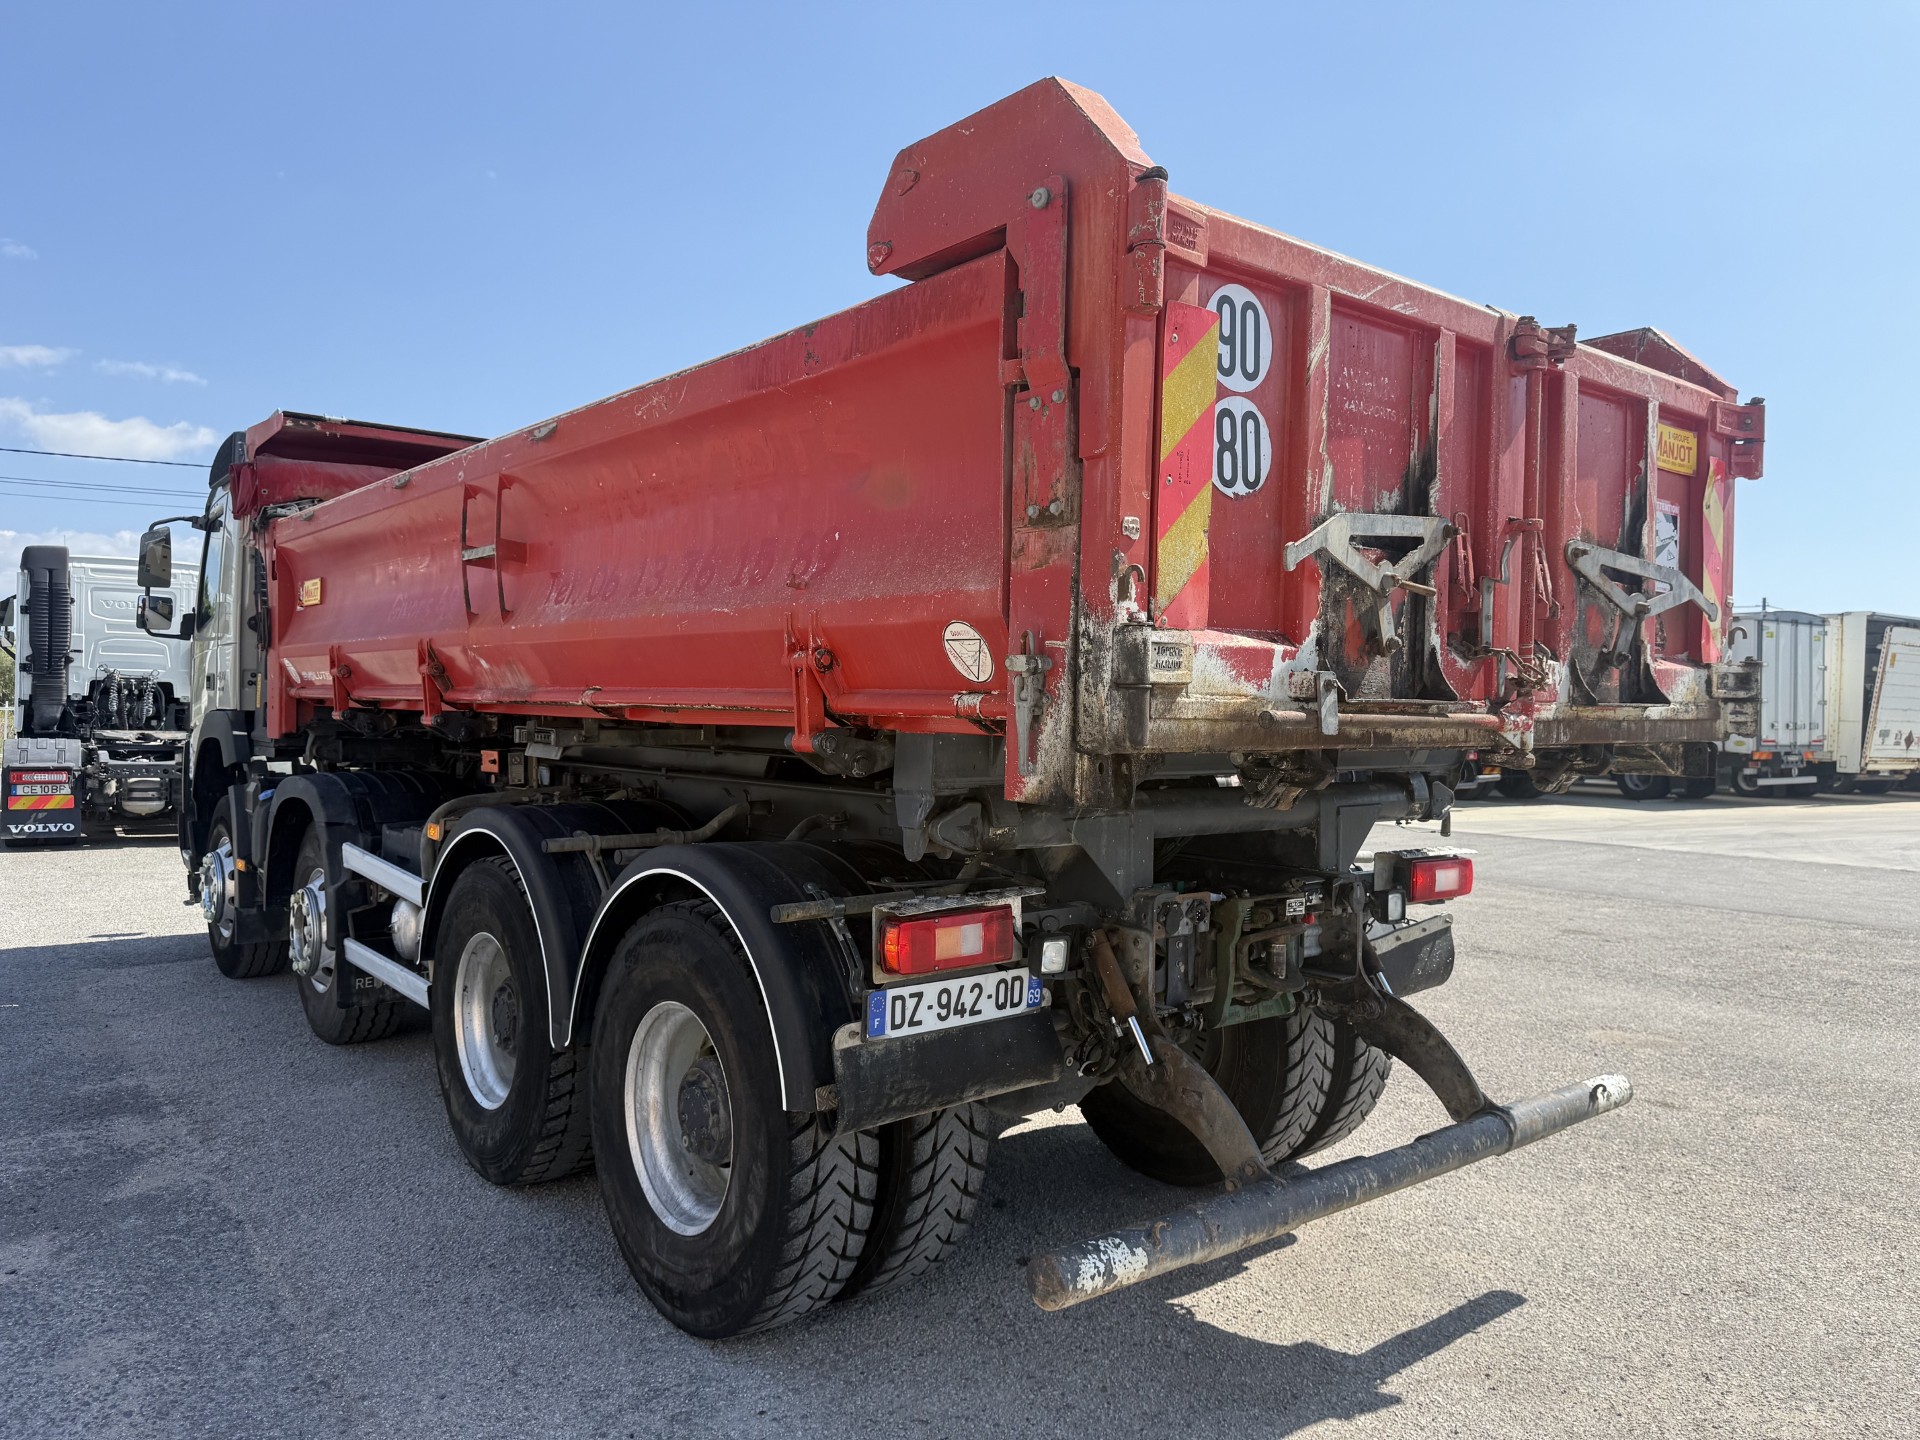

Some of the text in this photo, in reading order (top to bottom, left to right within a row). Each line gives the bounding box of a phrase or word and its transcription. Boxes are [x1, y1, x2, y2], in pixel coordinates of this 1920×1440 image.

[1216, 294, 1261, 382] 90
[1216, 407, 1261, 490] 80
[100, 599, 137, 610] VOL
[7, 823, 75, 834] VOLVO
[873, 1018, 881, 1029] F
[890, 975, 1024, 1031] DZ-942-QD
[1028, 988, 1041, 1004] 69
